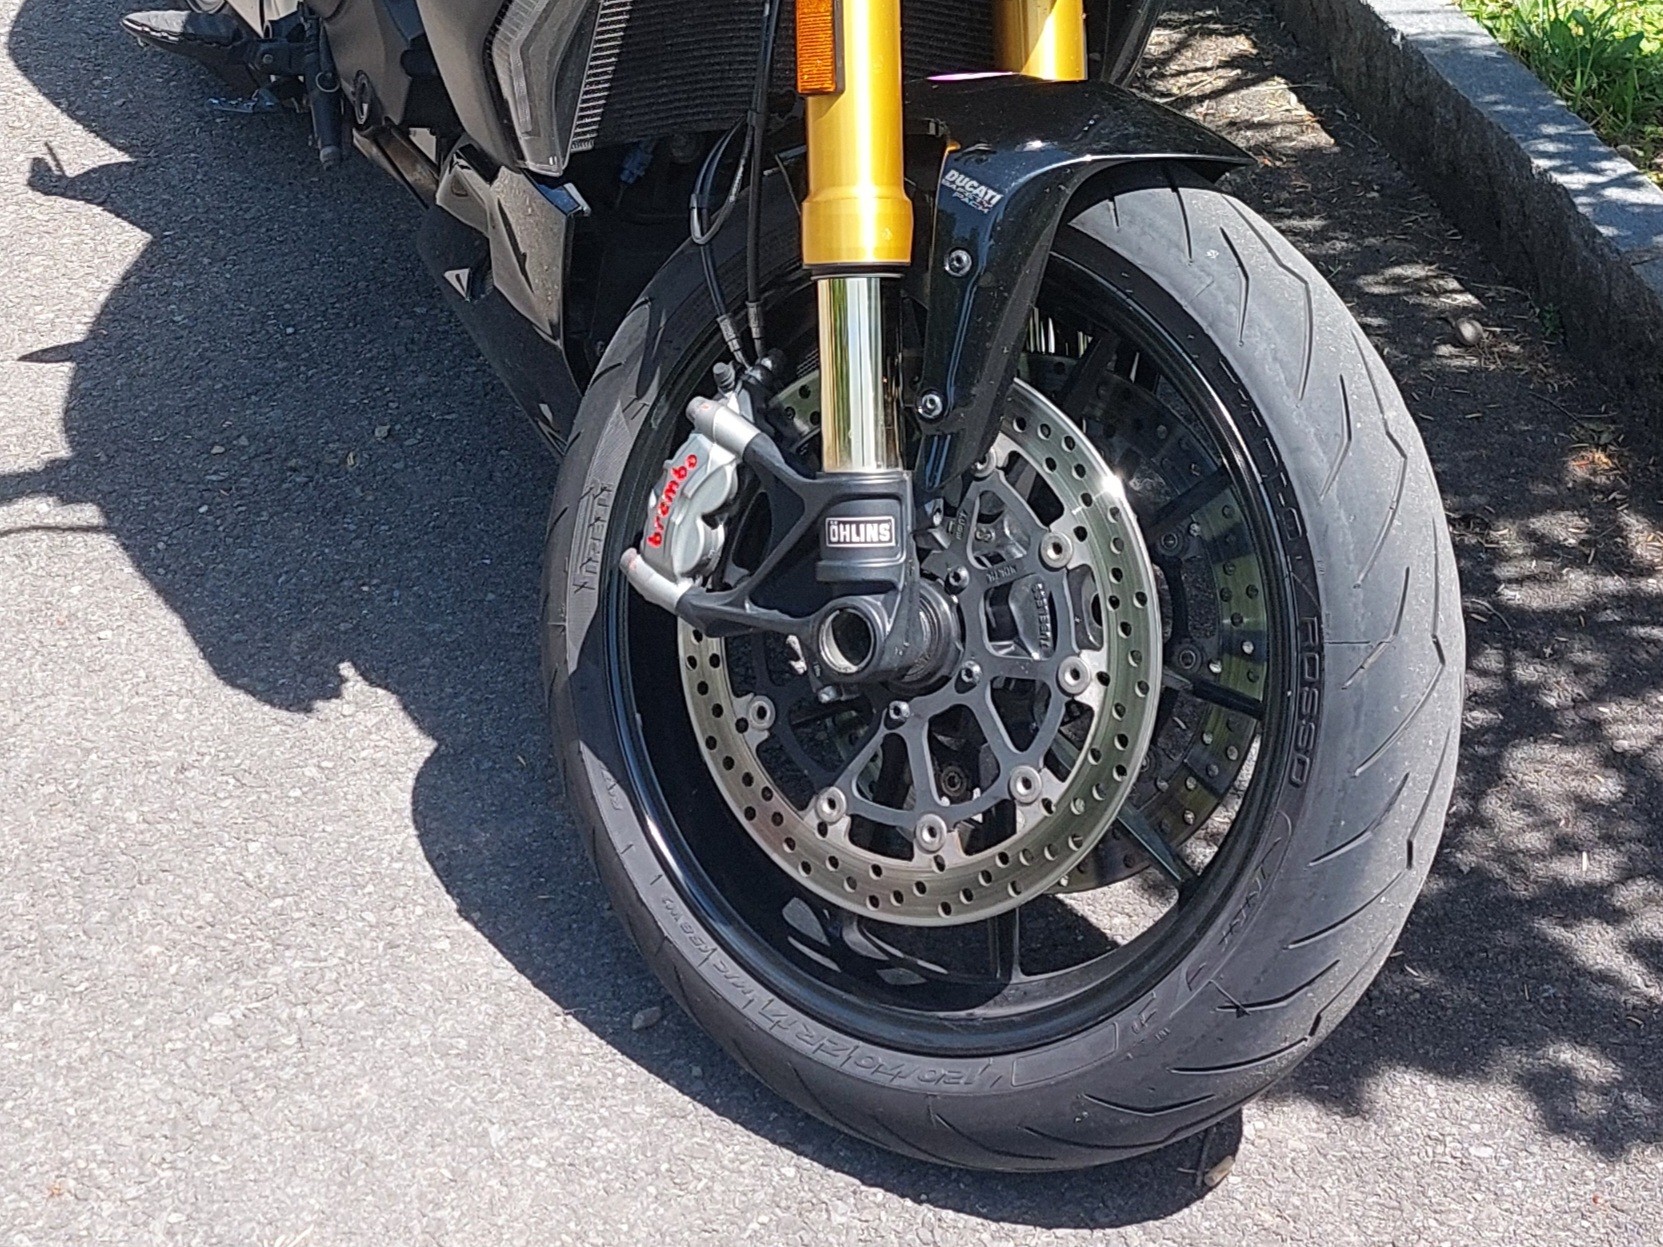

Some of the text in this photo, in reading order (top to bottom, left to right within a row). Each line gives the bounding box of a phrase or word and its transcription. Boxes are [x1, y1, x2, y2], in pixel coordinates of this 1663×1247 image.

[945, 169, 1004, 206] DUCATI
[646, 454, 697, 548] brembo
[830, 520, 890, 542] ÖHLINS
[1289, 616, 1320, 787] ROSSO
